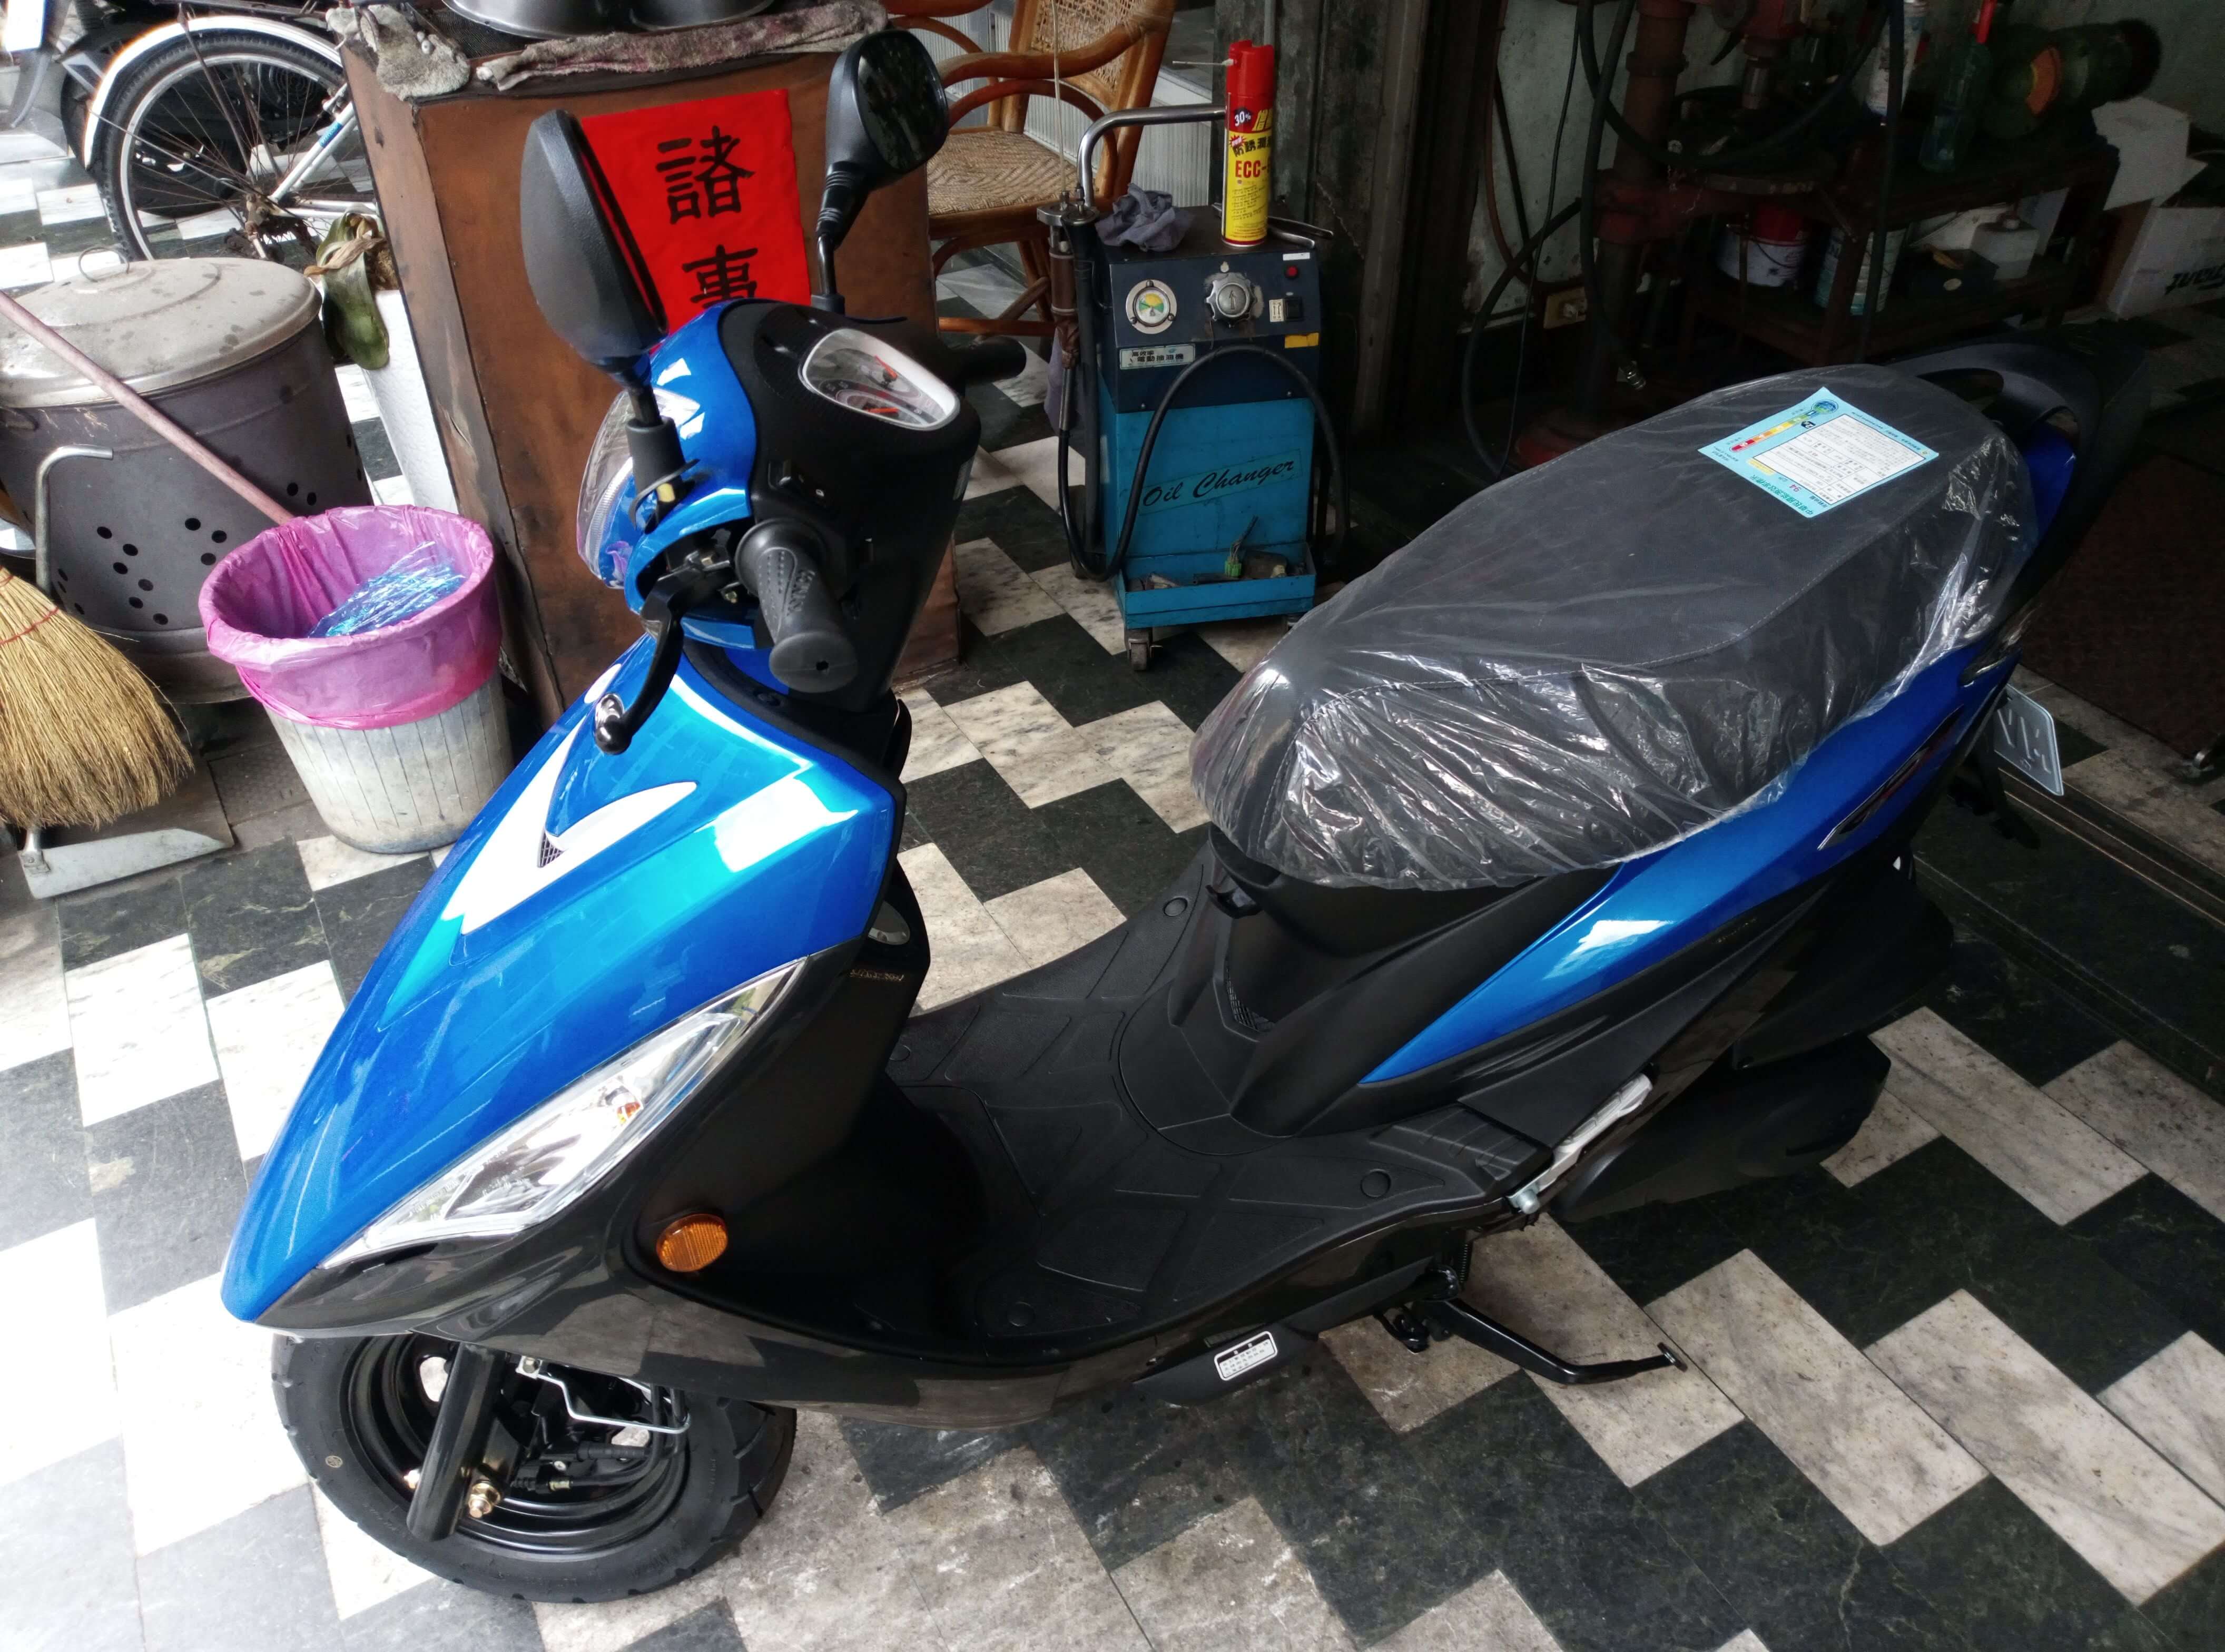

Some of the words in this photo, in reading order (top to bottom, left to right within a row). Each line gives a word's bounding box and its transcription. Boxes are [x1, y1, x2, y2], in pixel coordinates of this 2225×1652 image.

[1234, 111, 1252, 127] 30%
[1143, 481, 1184, 506] Oil
[1193, 460, 1294, 498] Changer
